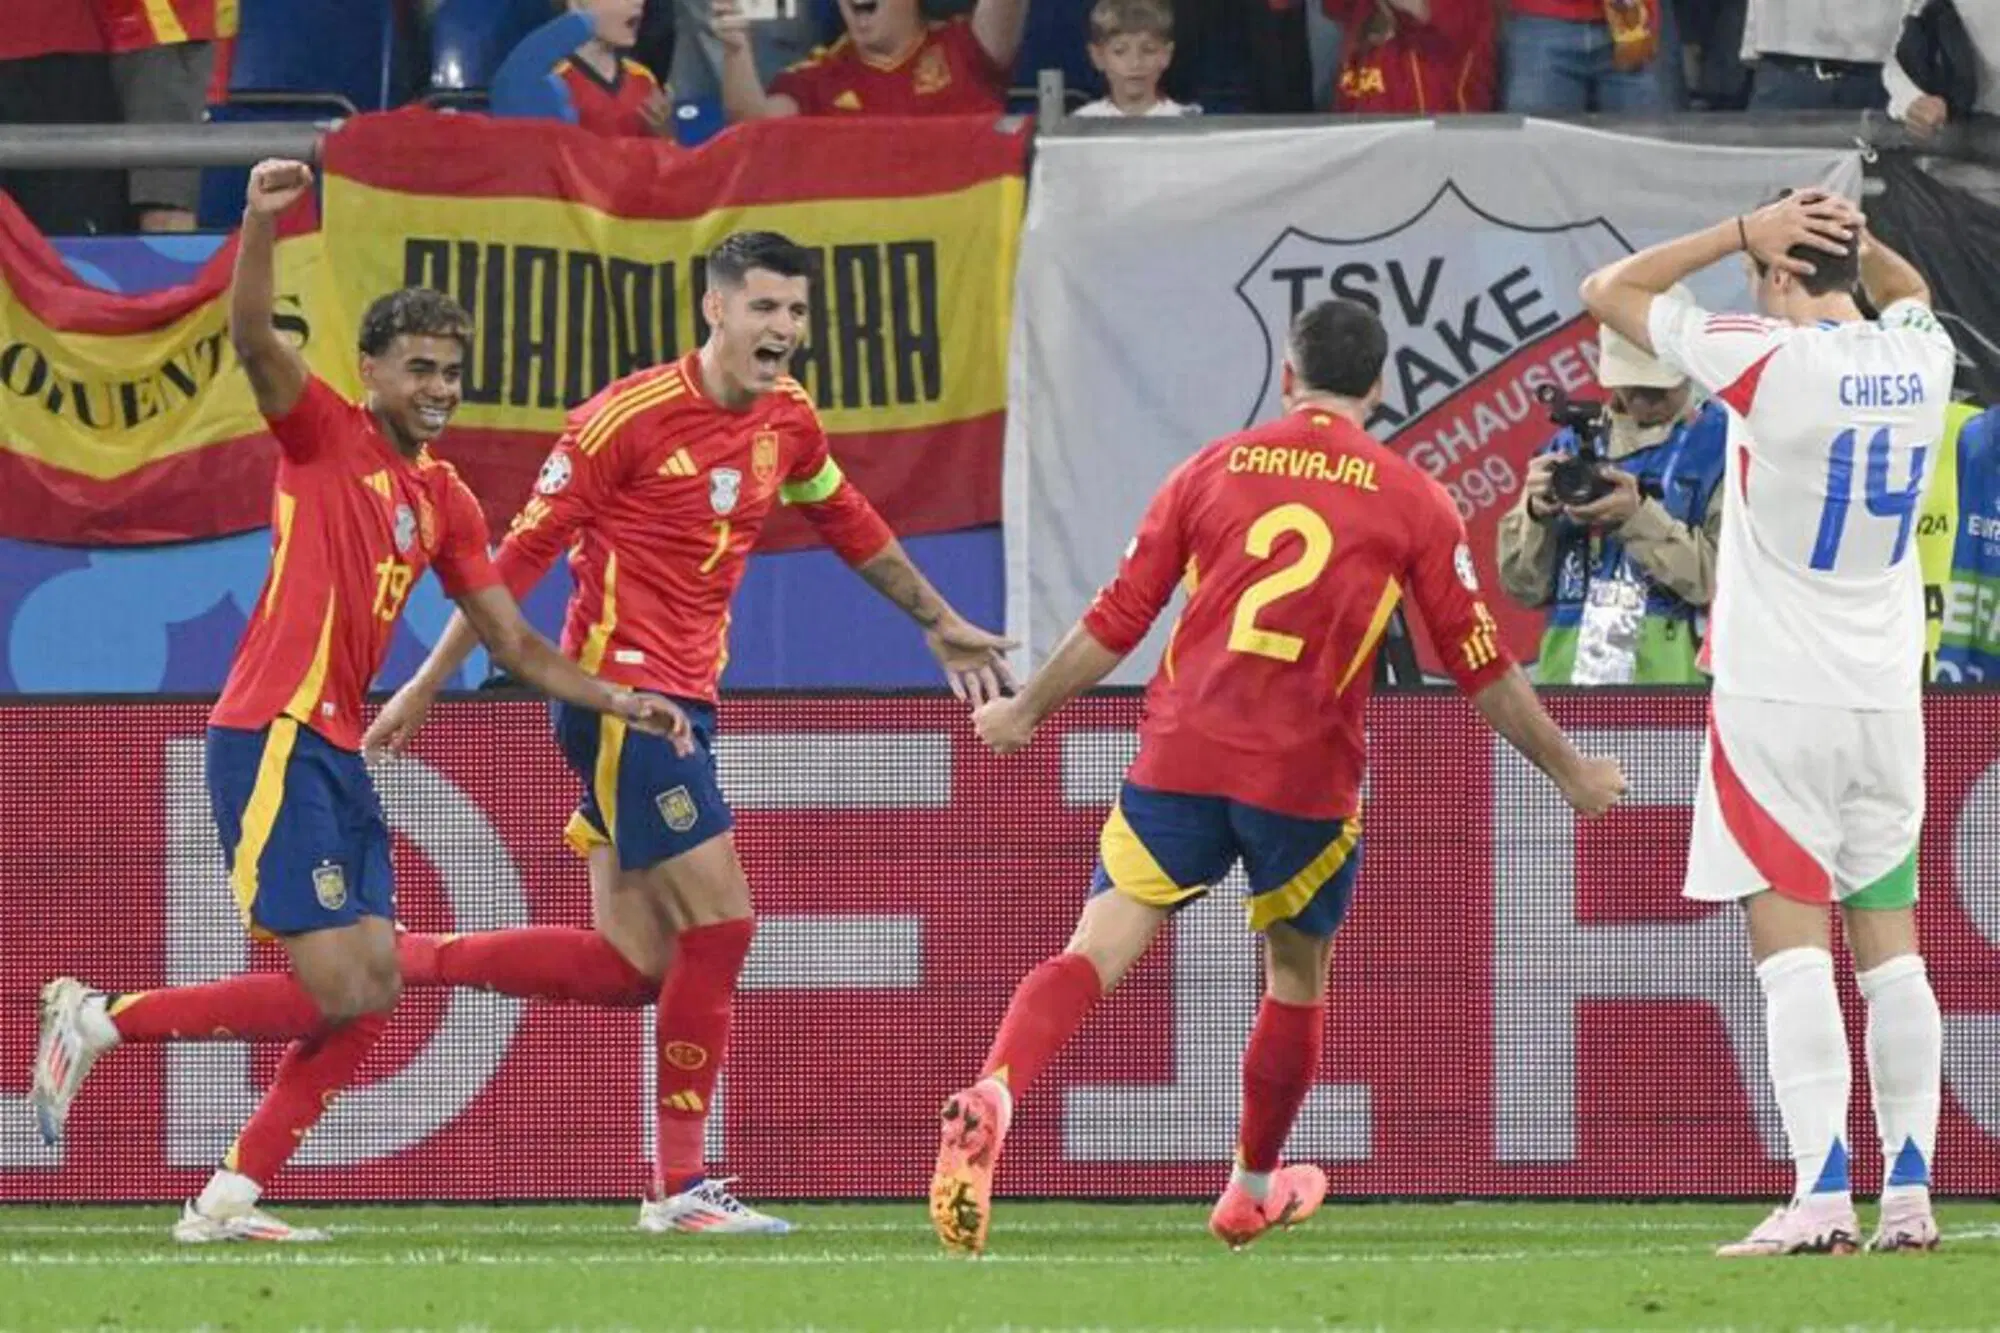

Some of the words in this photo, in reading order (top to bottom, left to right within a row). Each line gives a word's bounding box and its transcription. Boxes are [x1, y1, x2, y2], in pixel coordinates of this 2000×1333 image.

[1272, 257, 1445, 328] TSV
[1366, 266, 1561, 431] AKE
[1840, 373, 1925, 406] CHIESA
[1227, 446, 1379, 492] CARVAJAL
[1809, 425, 1928, 570] 14
[699, 519, 731, 574] 7
[372, 553, 413, 622] 19
[1227, 502, 1334, 663] 2
